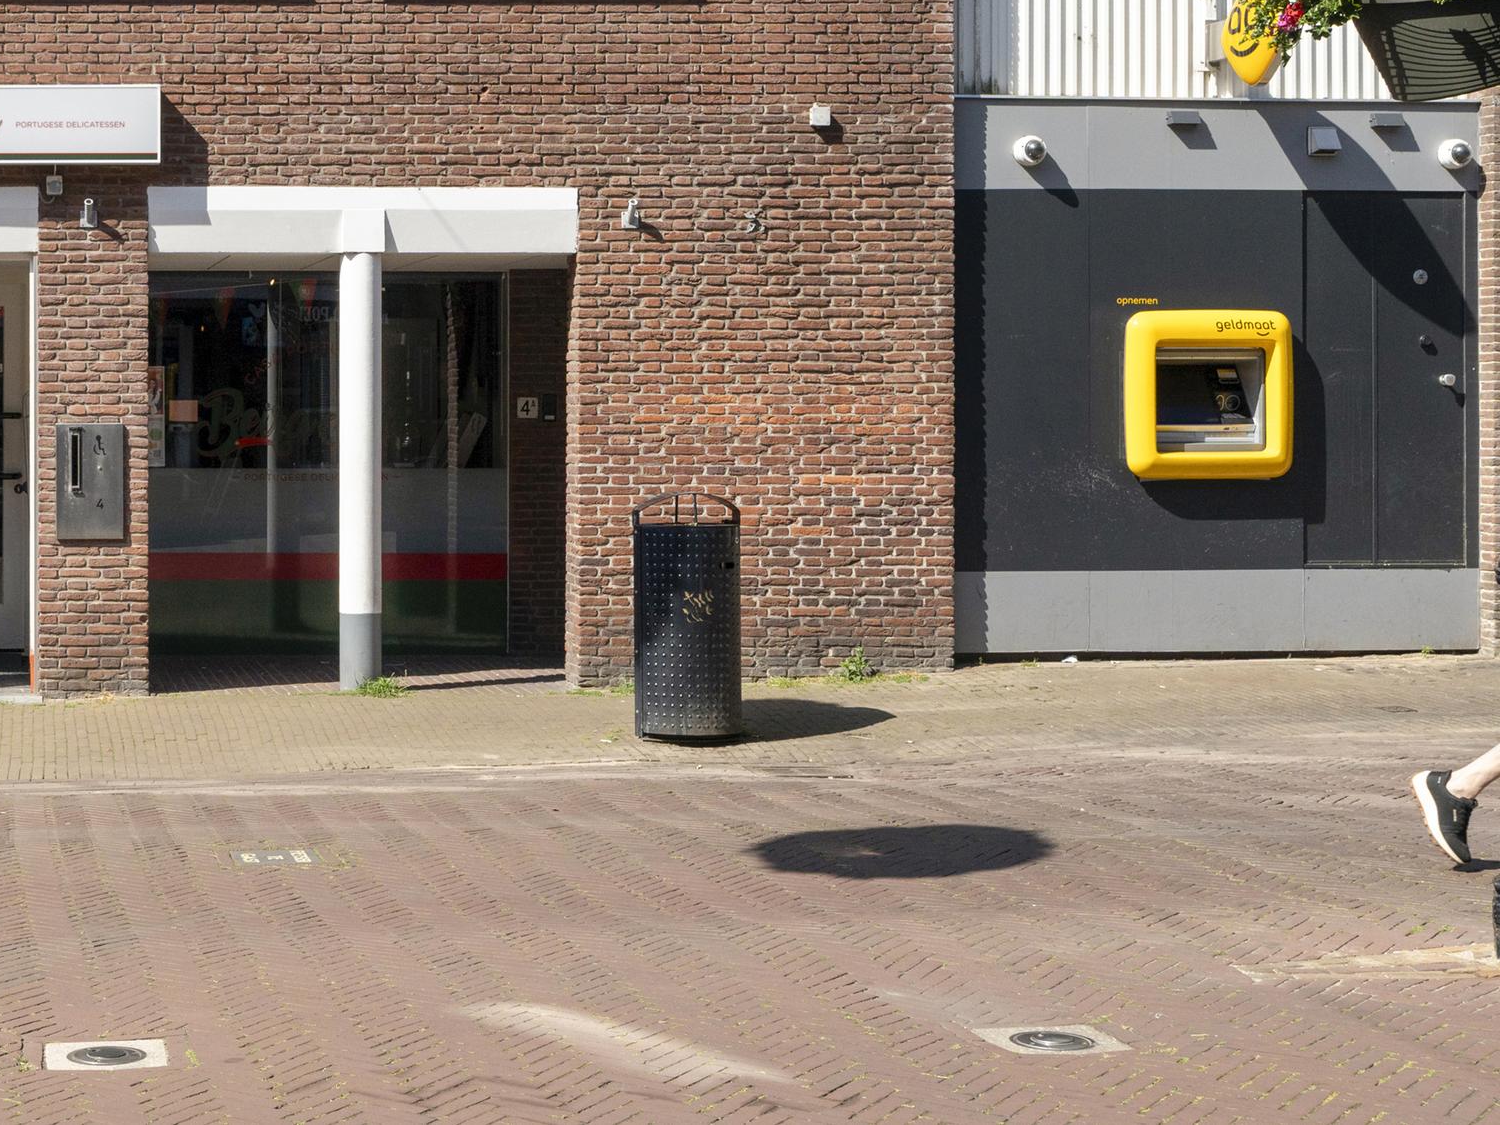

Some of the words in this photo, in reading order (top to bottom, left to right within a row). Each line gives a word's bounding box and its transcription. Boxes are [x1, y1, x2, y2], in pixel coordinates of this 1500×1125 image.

[15, 121, 64, 129] PORTUGESE
[66, 121, 125, 129] DELICATESSEN
[1116, 297, 1159, 307] opnemen
[1216, 320, 1276, 333] geldmaat
[96, 498, 104, 510] 4
